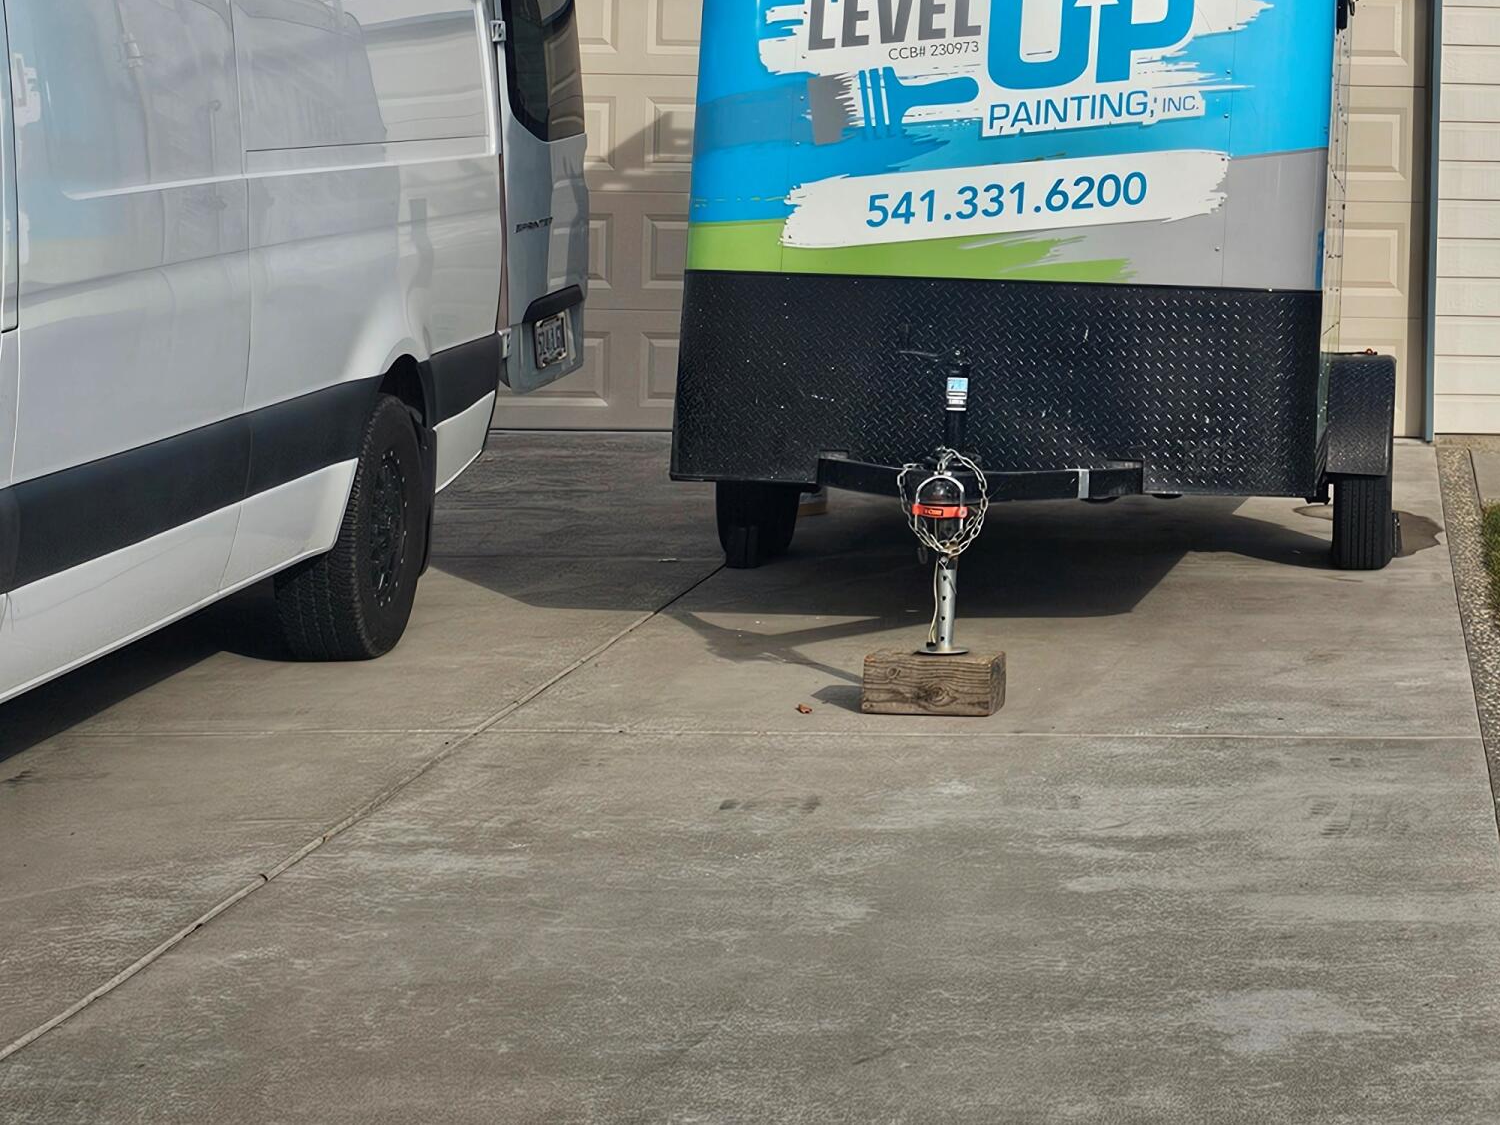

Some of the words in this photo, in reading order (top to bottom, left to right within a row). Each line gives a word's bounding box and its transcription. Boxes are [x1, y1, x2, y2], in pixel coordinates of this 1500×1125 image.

[888, 46, 925, 60] CCB#
[930, 40, 979, 57] 230973
[1162, 95, 1199, 112] INC.
[866, 171, 1147, 228] 541.331.6200
